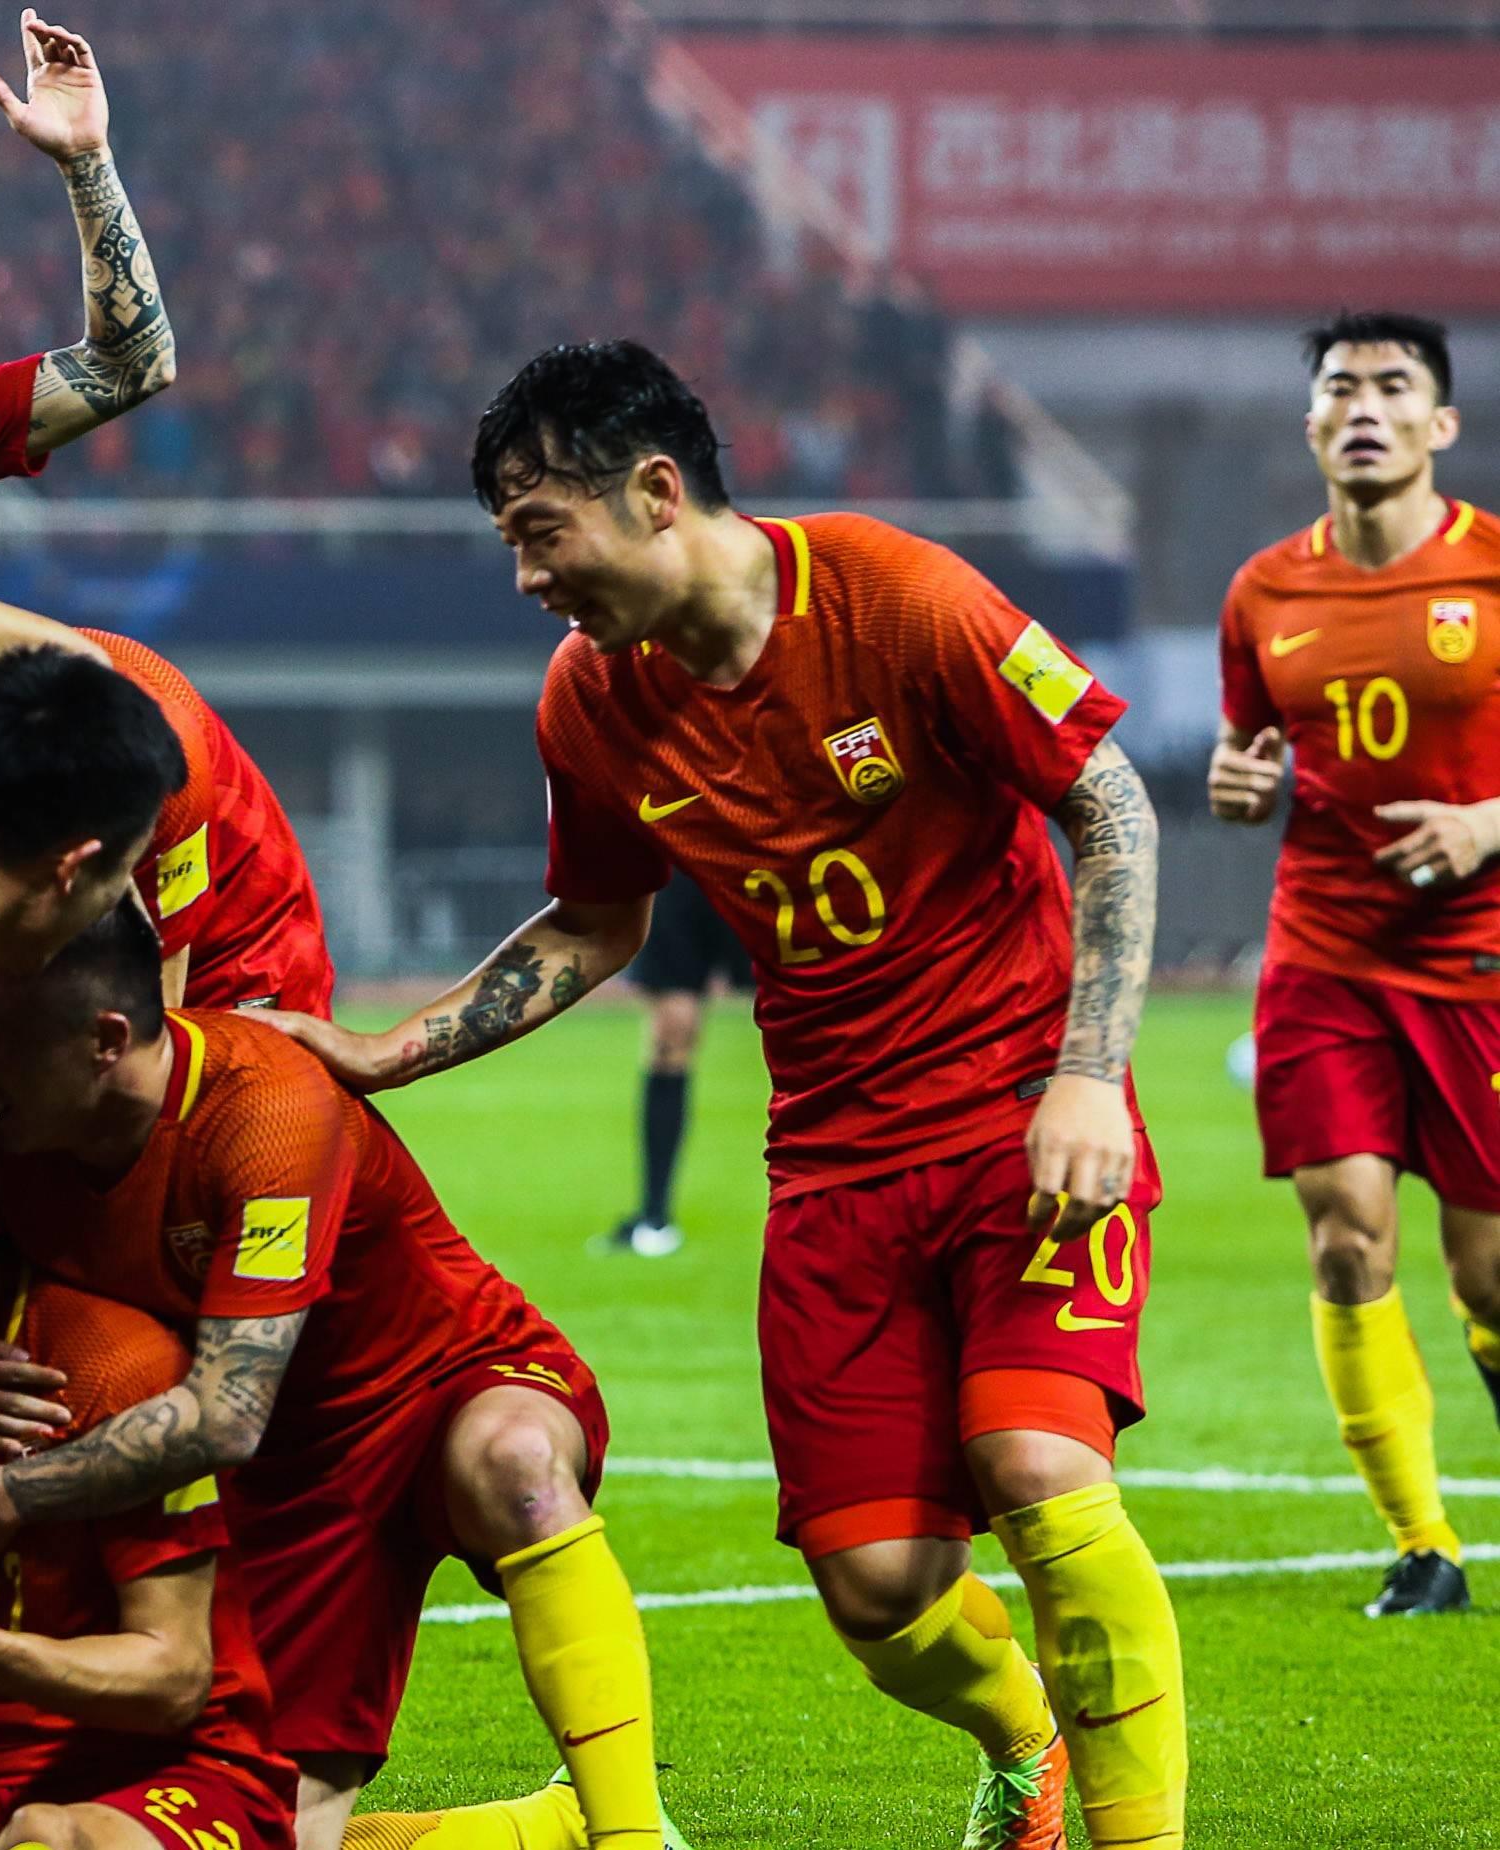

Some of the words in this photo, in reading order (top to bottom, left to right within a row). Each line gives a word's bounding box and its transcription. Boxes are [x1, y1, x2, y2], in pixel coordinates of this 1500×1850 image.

[830, 724, 880, 757] CFA
[1324, 676, 1409, 761] 10
[744, 848, 886, 965] 20
[1019, 1190, 1137, 1306] 20
